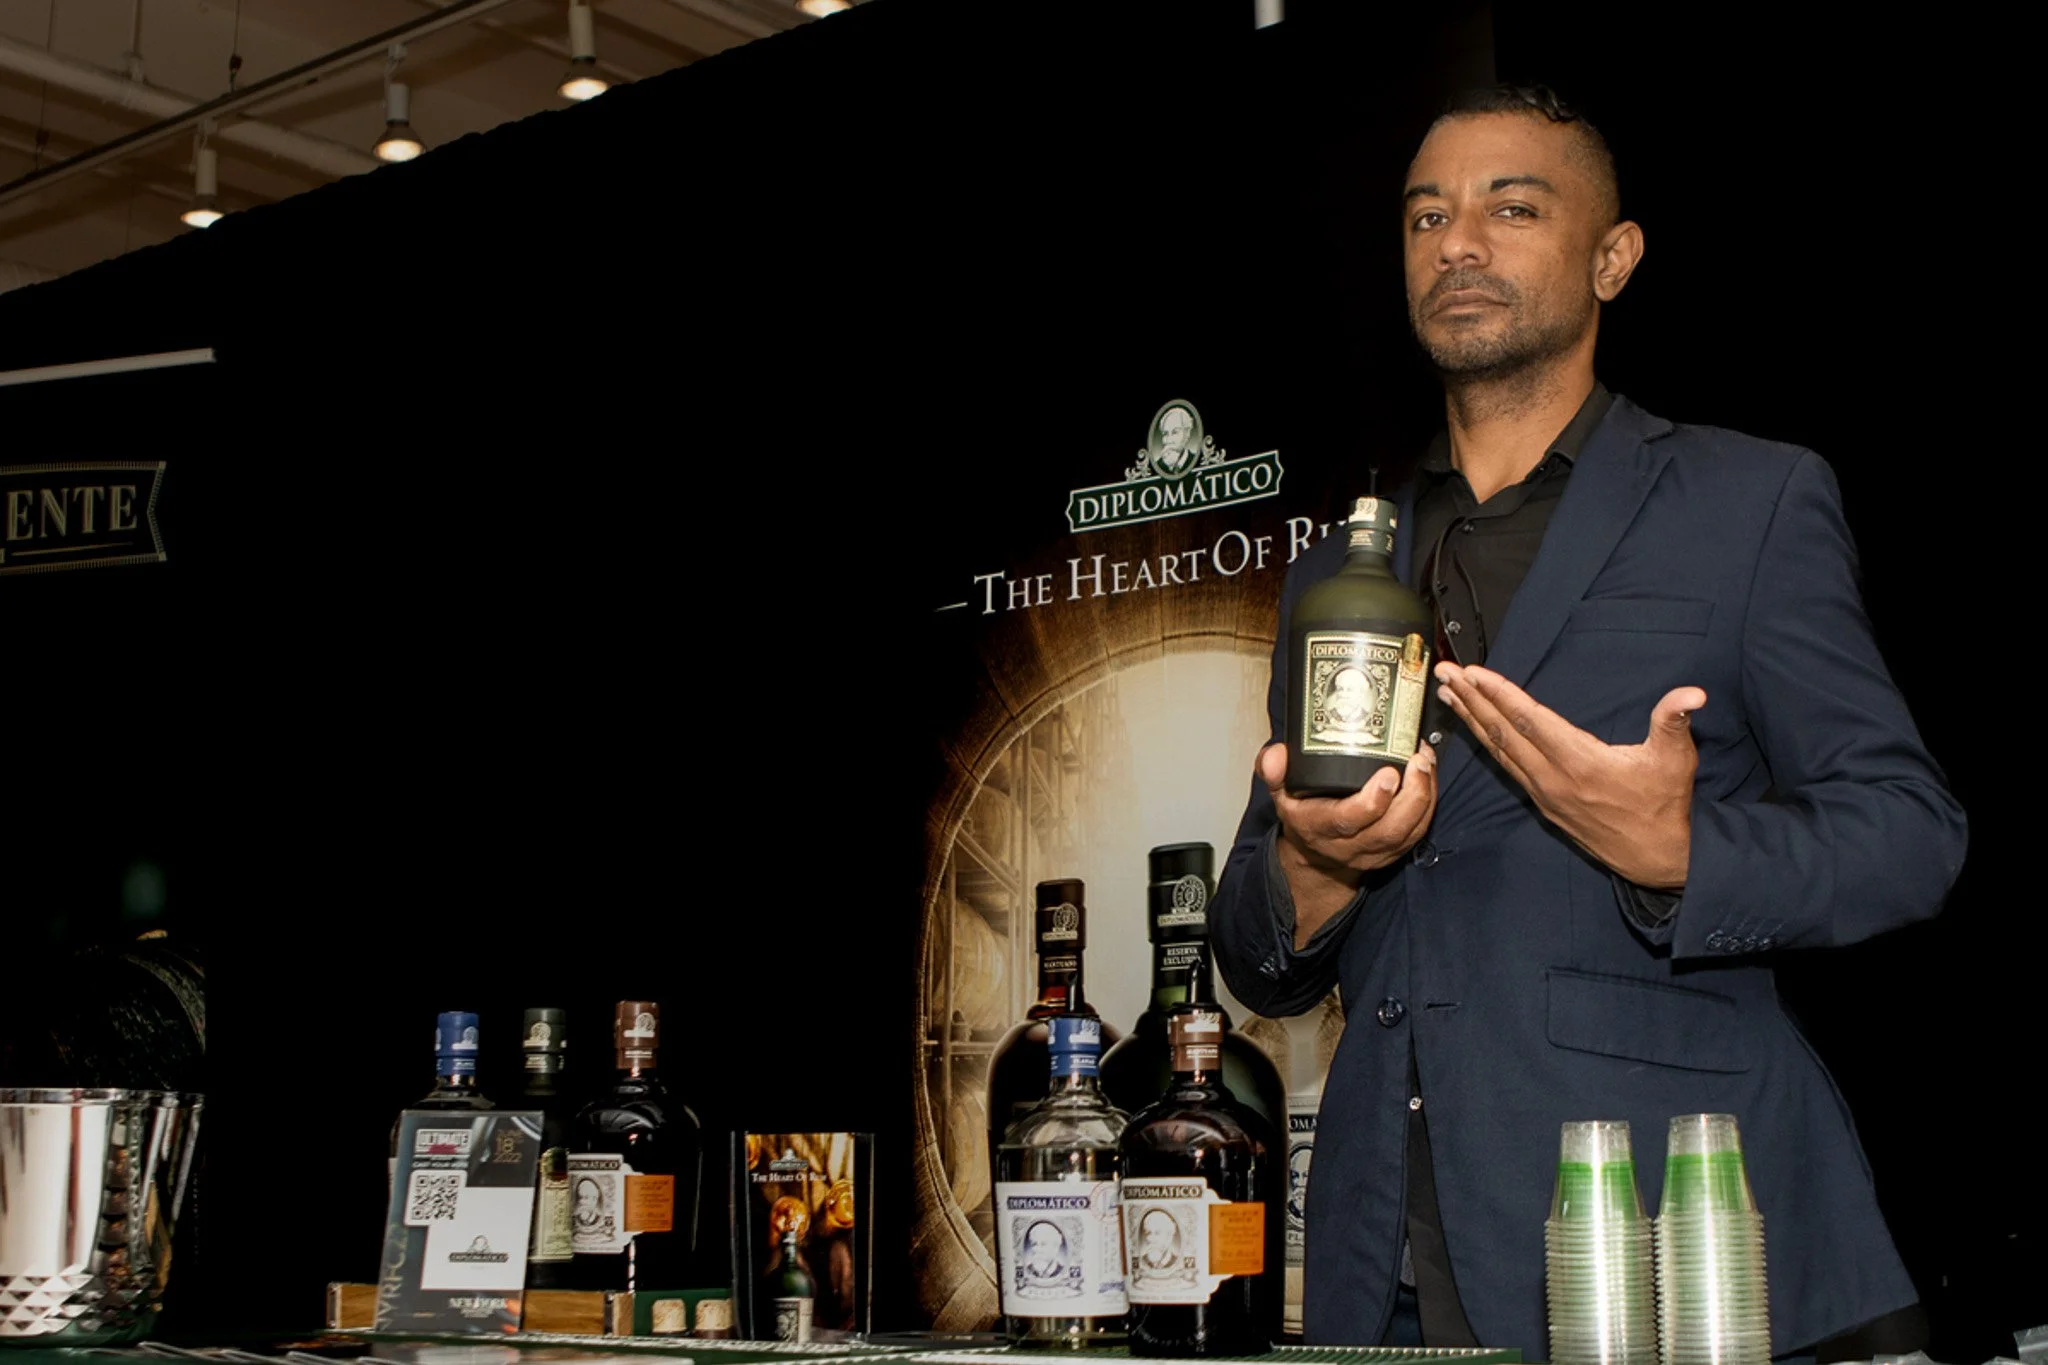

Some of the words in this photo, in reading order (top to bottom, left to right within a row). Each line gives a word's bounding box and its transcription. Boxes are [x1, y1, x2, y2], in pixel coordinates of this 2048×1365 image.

[1078, 462, 1272, 524] DIPLOMÁTICO
[6, 484, 138, 541] ENTE
[973, 570, 1054, 615] THE
[1066, 546, 1208, 602] HEART
[1212, 530, 1273, 577] OF
[1167, 946, 1198, 956] RESERVA
[1009, 1196, 1087, 1209] DIPLOMÁTICO
[1126, 1185, 1200, 1198] DIPLOMÁTICO
